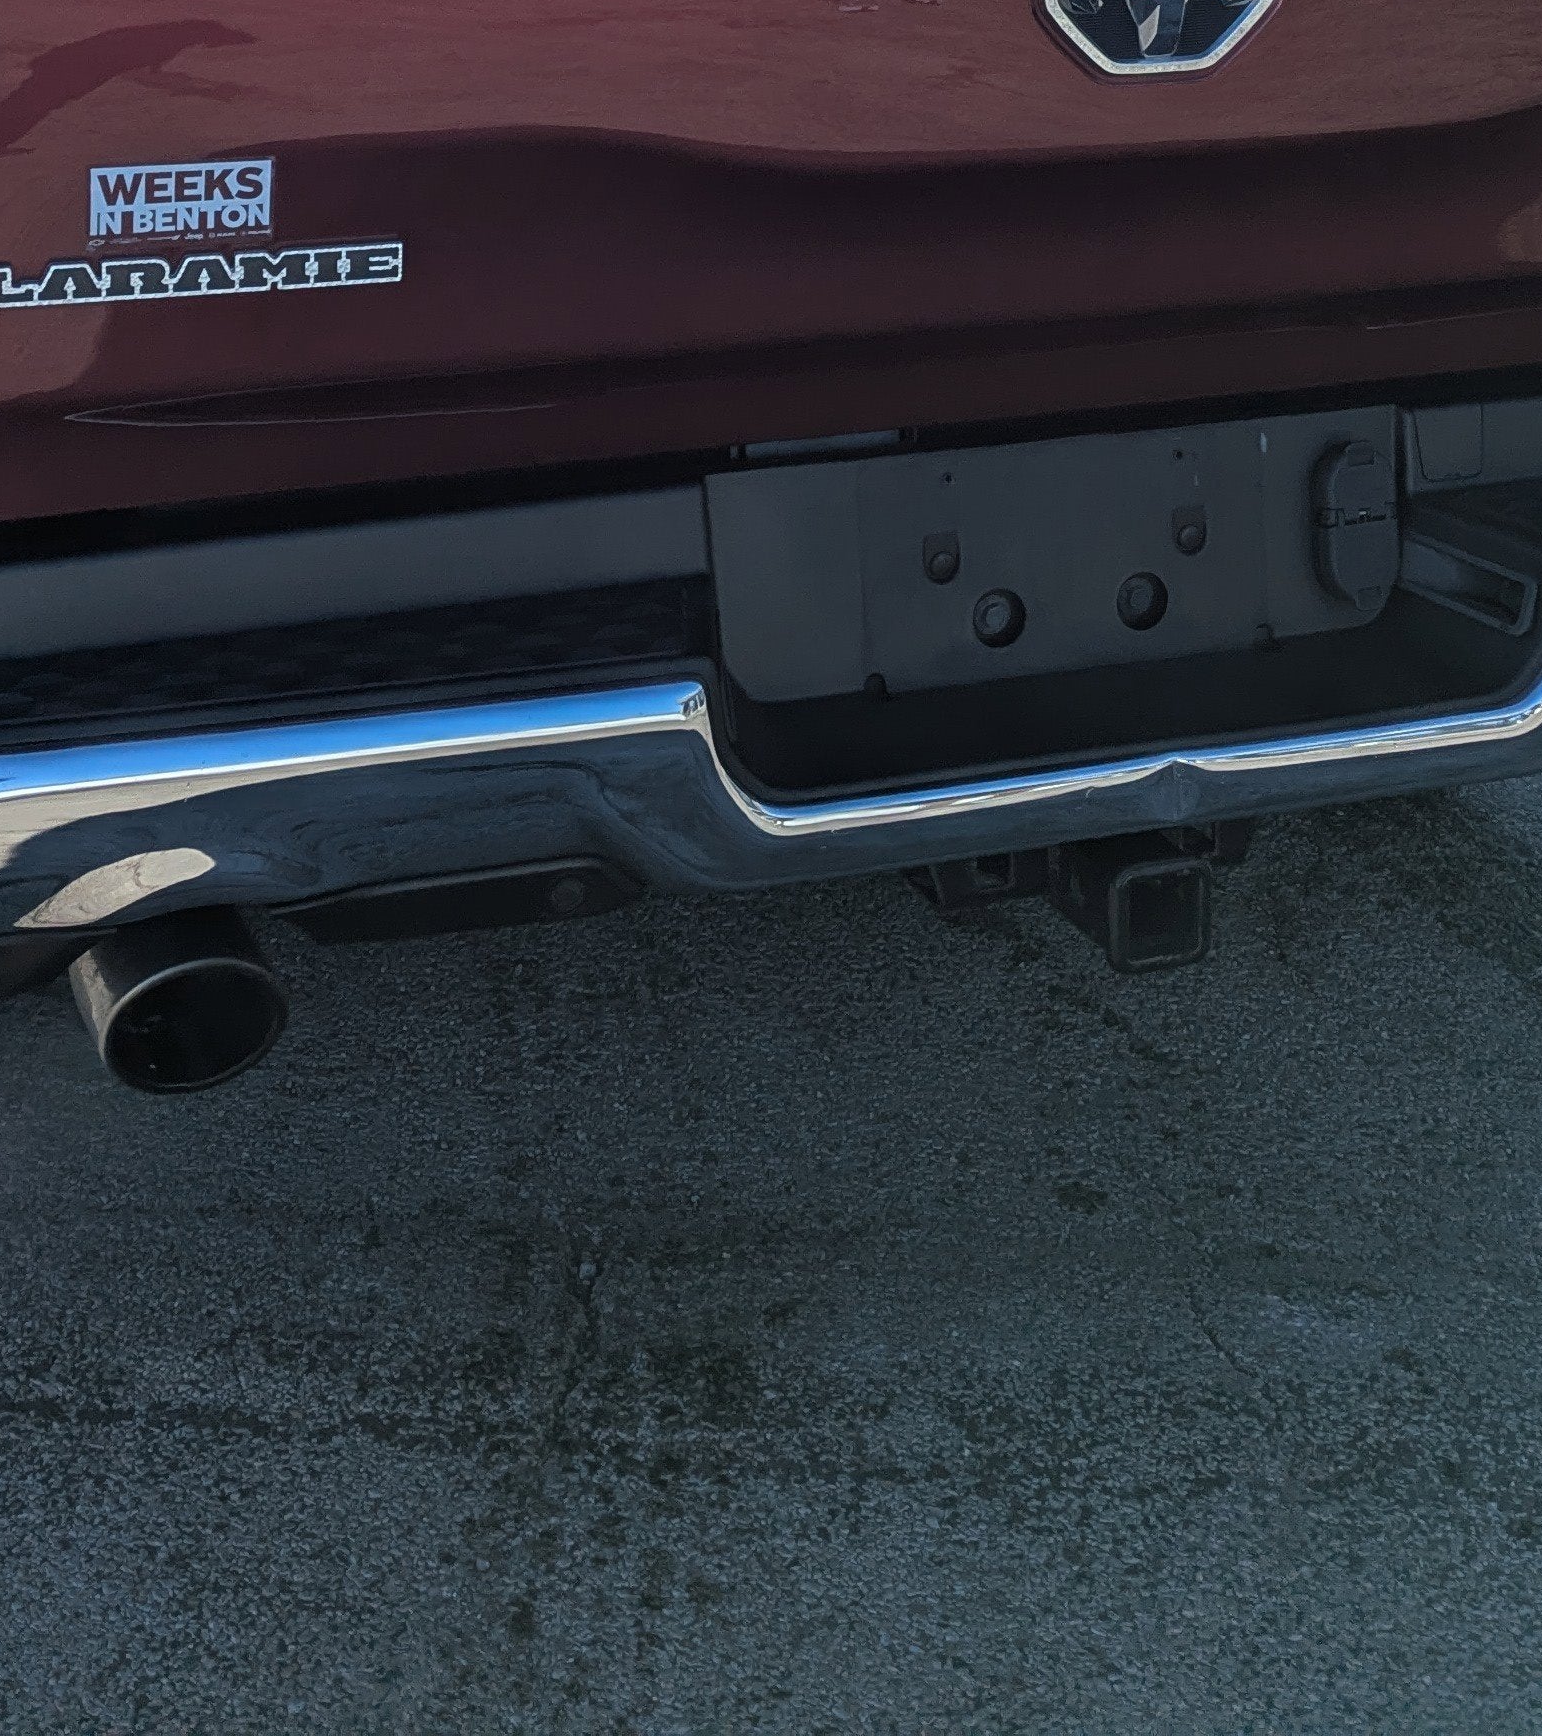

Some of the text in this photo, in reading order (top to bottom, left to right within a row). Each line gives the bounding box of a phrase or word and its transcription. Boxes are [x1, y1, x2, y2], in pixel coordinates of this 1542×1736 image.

[97, 167, 264, 206] WEEKS
[89, 203, 270, 236] IN BENTON
